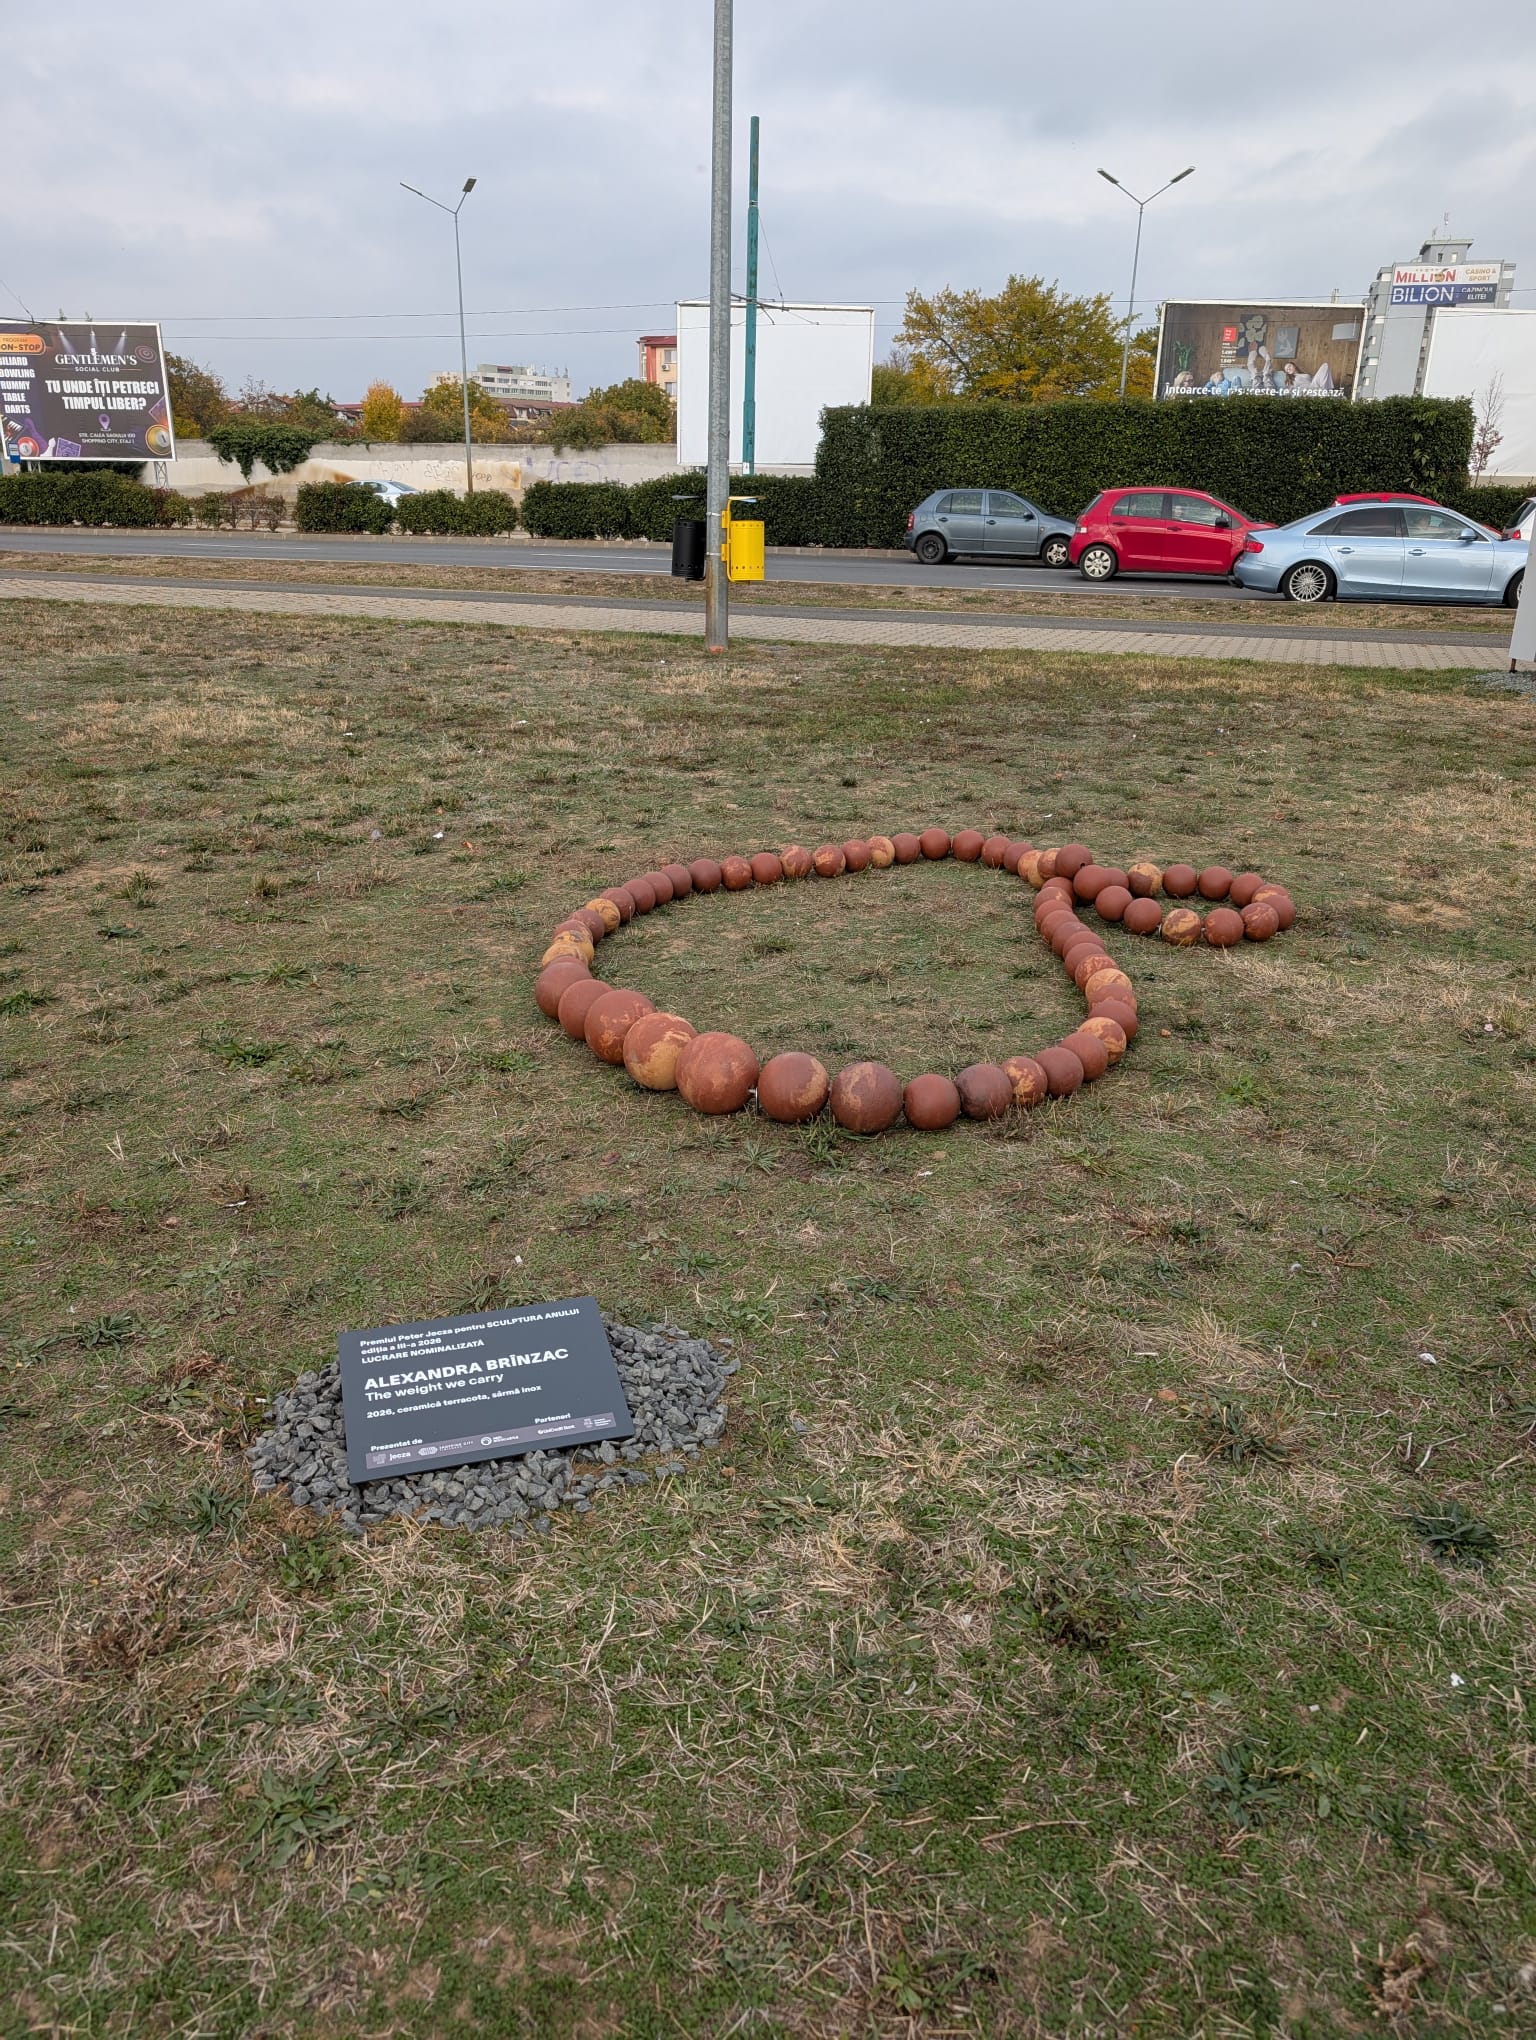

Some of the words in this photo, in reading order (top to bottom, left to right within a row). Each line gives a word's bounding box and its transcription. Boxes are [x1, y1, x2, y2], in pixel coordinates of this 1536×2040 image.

[1396, 269, 1456, 283] MILLION
[1392, 287, 1455, 302] BILION
[0, 343, 41, 351] ON-STOP
[55, 353, 137, 365] GENTLEMEN'S
[0, 381, 30, 390] RUMMY
[45, 380, 61, 393] TU
[62, 380, 94, 394] UNDE
[112, 380, 160, 395] PETRECI
[2, 393, 26, 402] TABLE
[61, 396, 105, 410] TIMPUL
[106, 397, 147, 410] LIBER?
[5, 405, 31, 414] DARTS
[360, 1336, 396, 1347] Premiul
[398, 1333, 424, 1342] Peter
[425, 1328, 453, 1337] Jecza
[454, 1323, 486, 1335] pentru
[486, 1314, 544, 1328] SCULPTURA
[544, 1308, 580, 1320] ANULUI
[361, 1351, 409, 1364] LUCRARE
[410, 1338, 485, 1356] NOMINALIZATĂ
[397, 1342, 417, 1350] III-a
[364, 1362, 483, 1390] ALEXANDRA
[485, 1348, 569, 1371] BRÎNZAC
[365, 1391, 392, 1402] The
[395, 1382, 443, 1397] weight
[445, 1379, 466, 1389] we
[468, 1373, 504, 1385] carry
[367, 1408, 396, 1419] 2026,
[397, 1400, 442, 1414] ceramică
[443, 1393, 490, 1407] terracota,
[521, 1384, 542, 1393] inox
[535, 1412, 571, 1424] Parteneri
[370, 1440, 411, 1452] Prezentat
[389, 1452, 411, 1461] jecza
